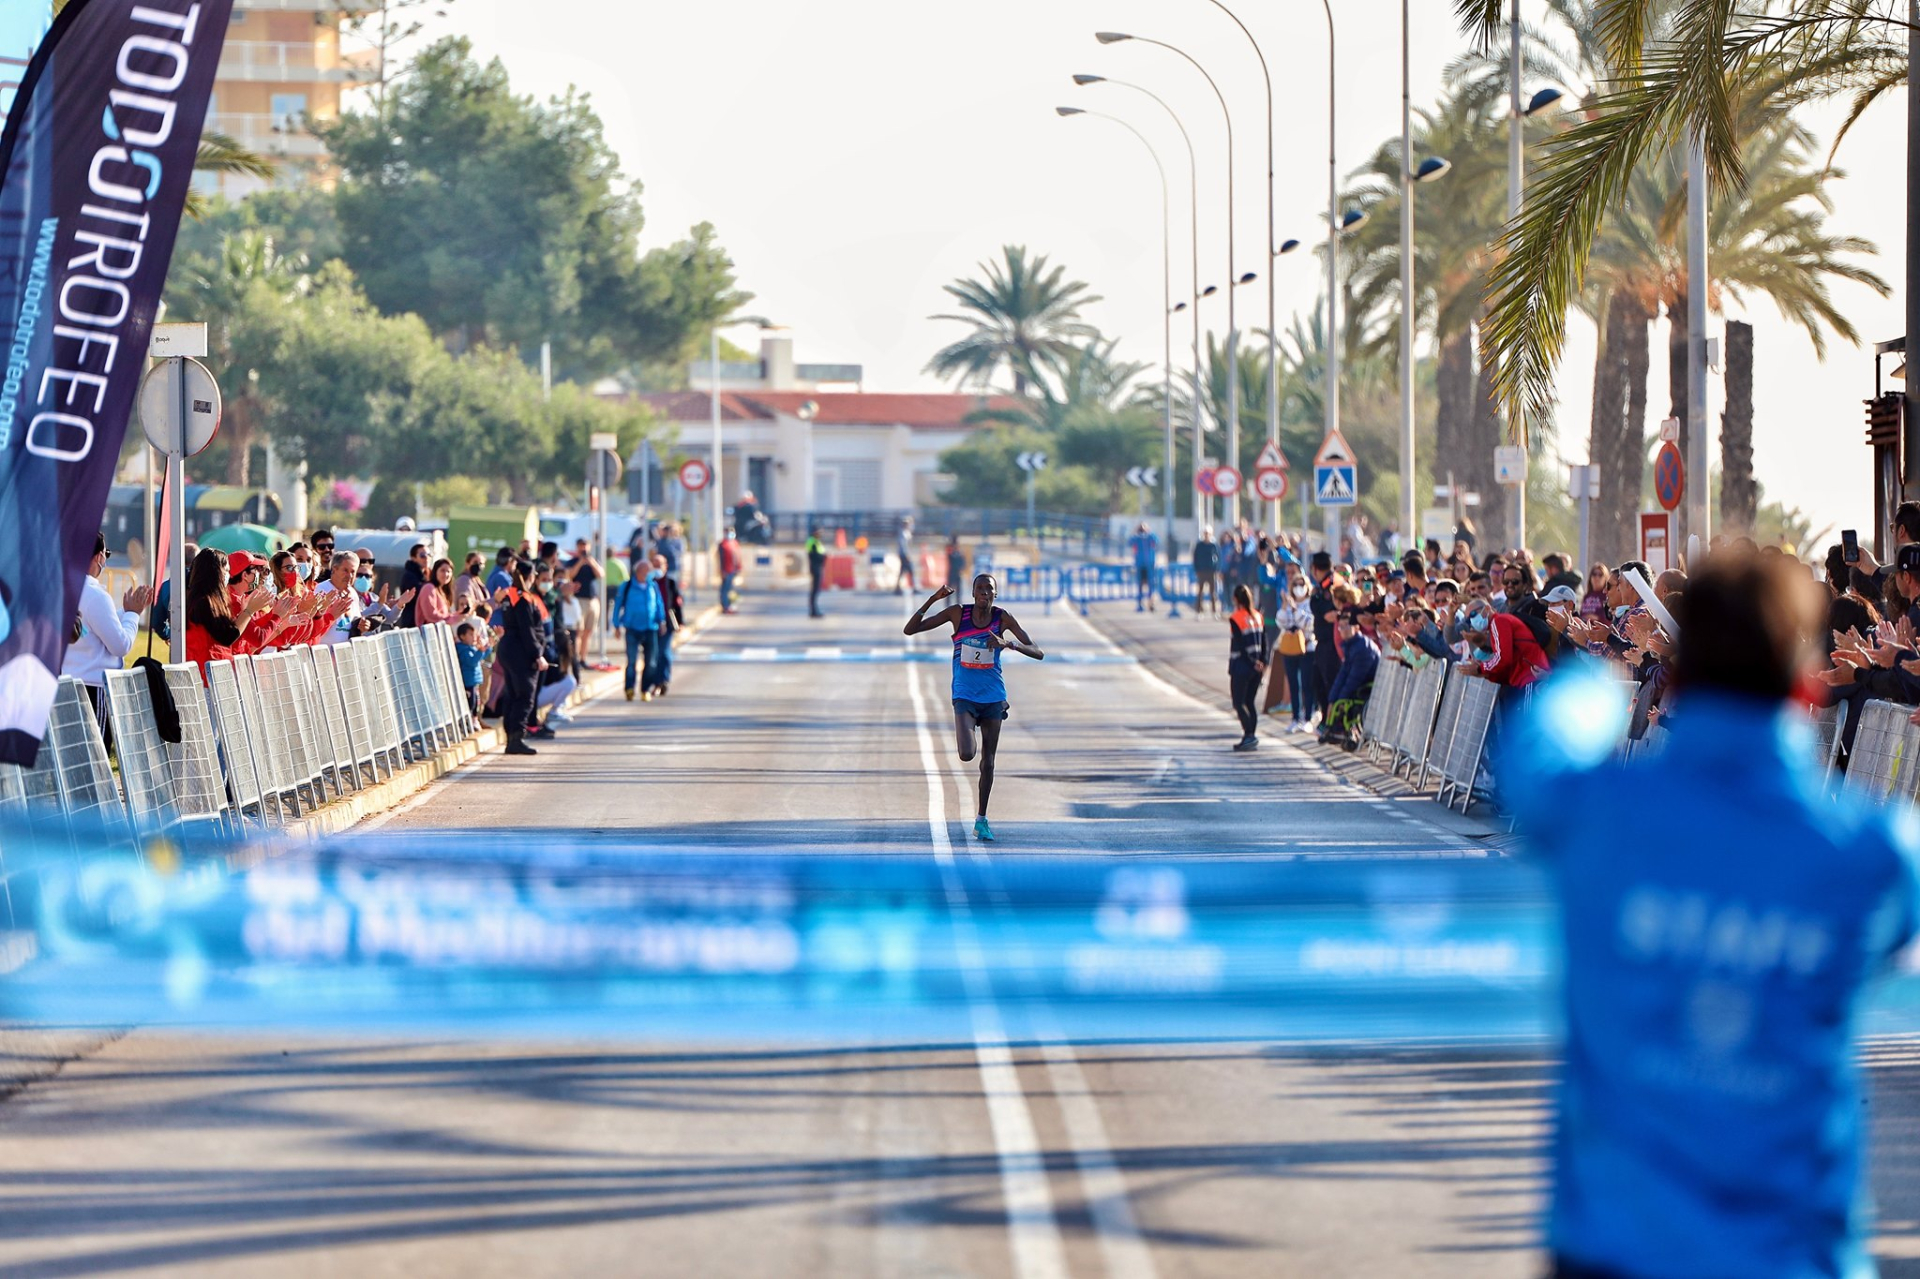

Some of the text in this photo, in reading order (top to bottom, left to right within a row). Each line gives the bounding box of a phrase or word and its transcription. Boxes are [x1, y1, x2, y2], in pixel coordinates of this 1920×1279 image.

[0, 217, 59, 451] www.todotrofeo.com
[25, 3, 201, 462] TODOTROFEO
[974, 651, 981, 660] 2
